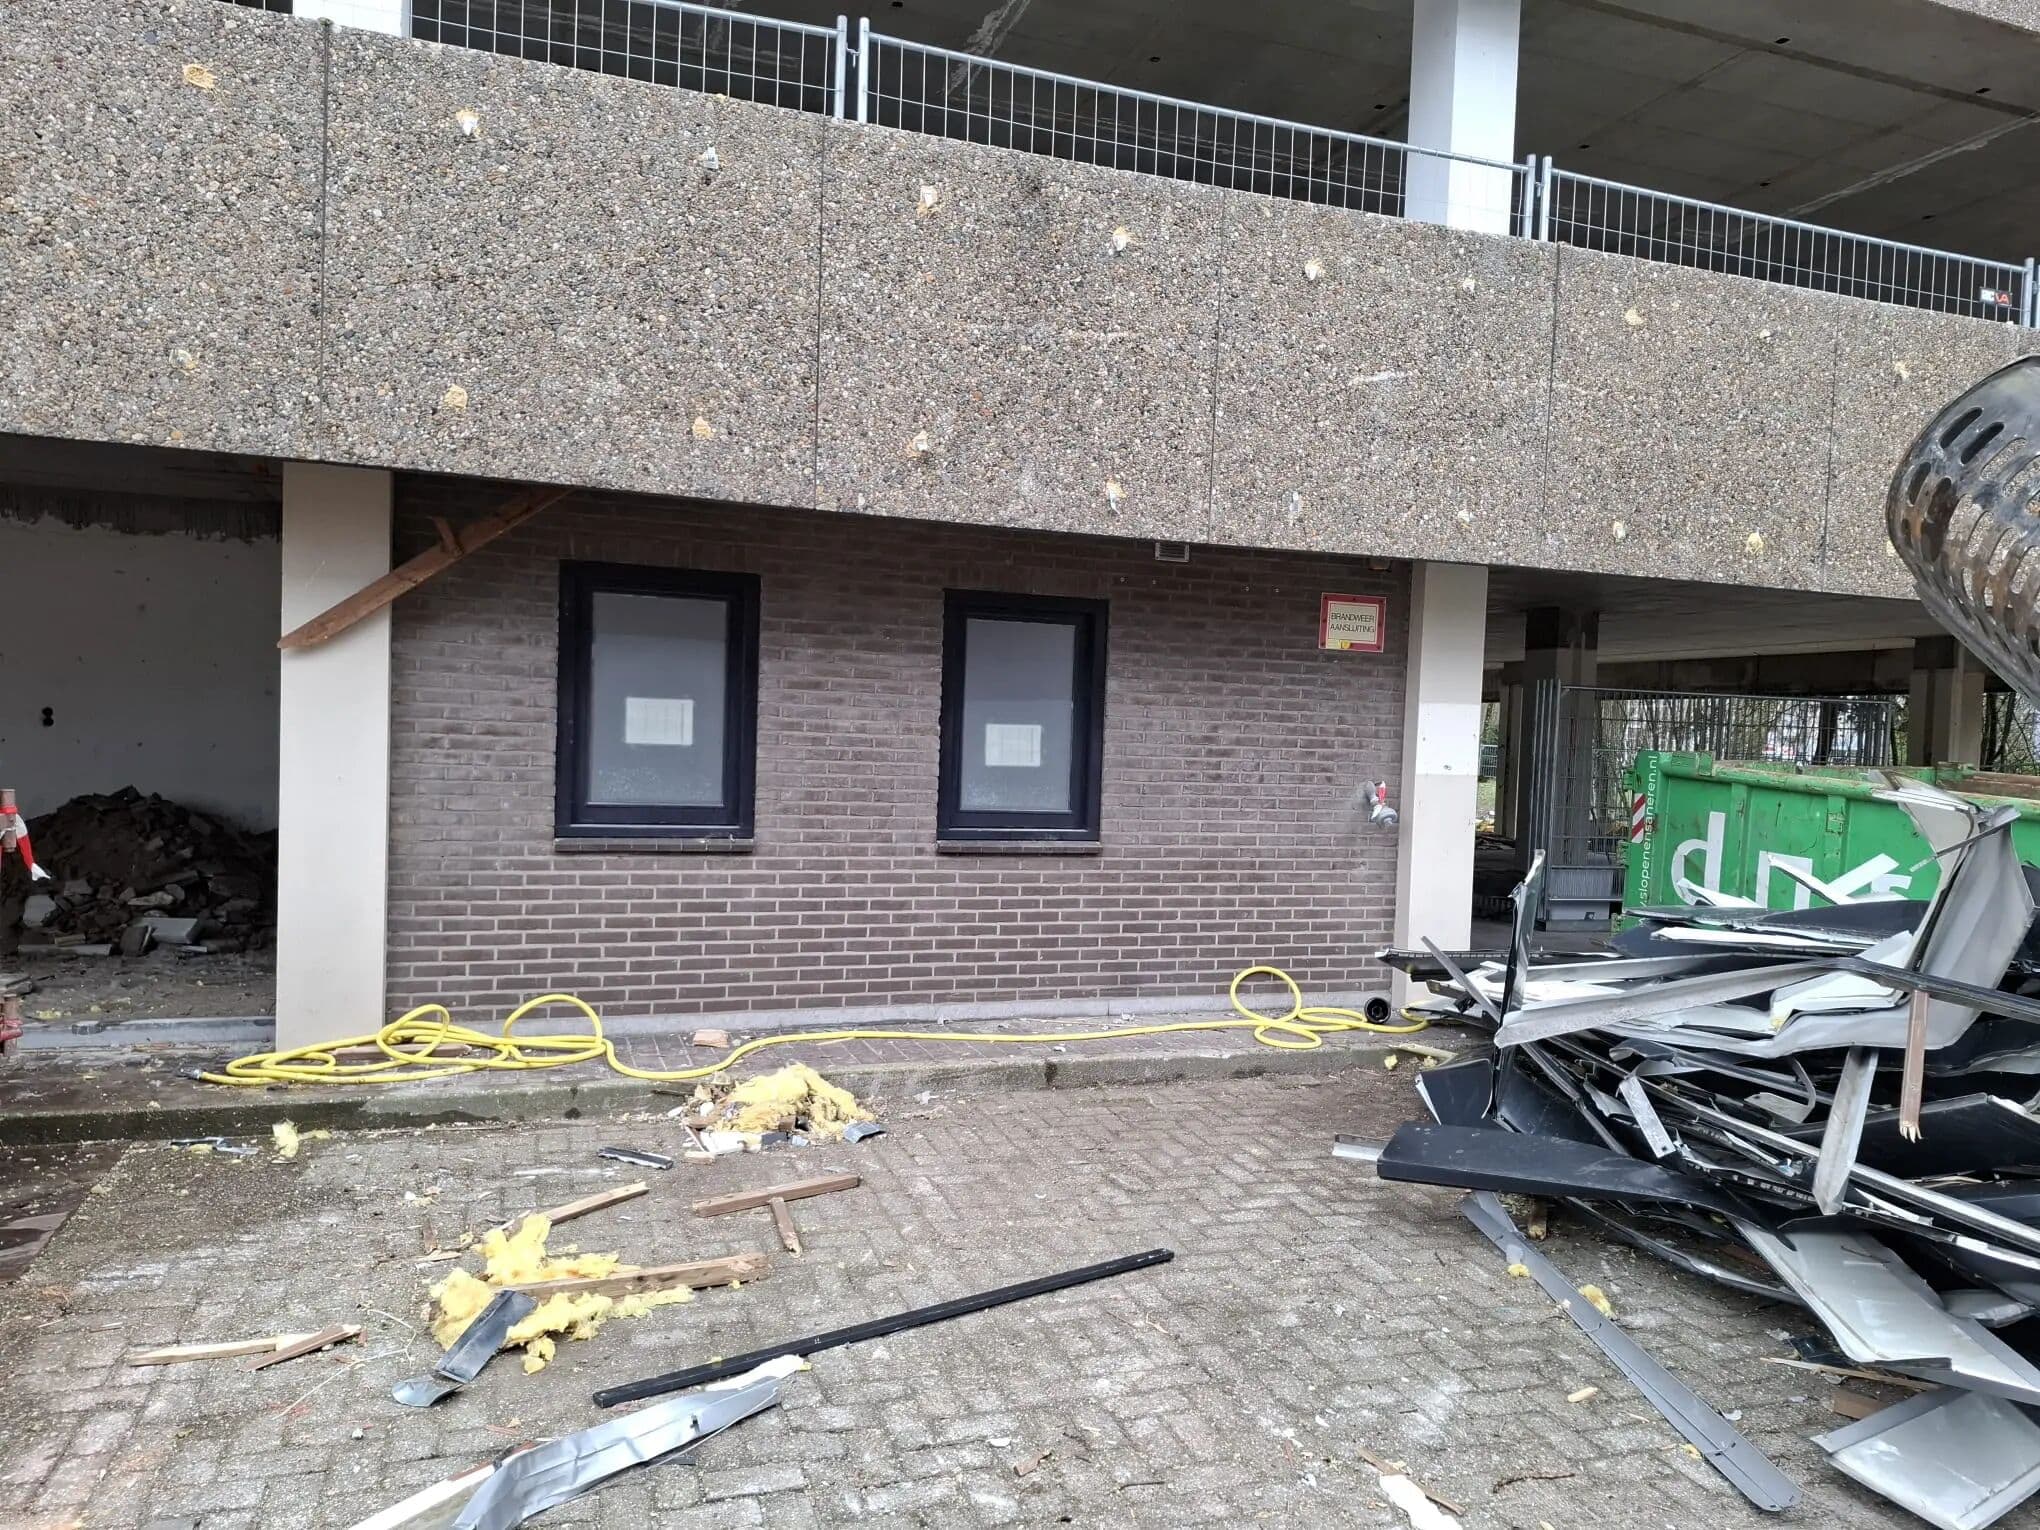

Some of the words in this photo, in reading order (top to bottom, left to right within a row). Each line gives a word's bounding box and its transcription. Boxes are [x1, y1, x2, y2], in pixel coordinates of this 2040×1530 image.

[1331, 612, 1374, 622] BRANDWEER
[1330, 623, 1374, 632] AANSLUITING
[1638, 755, 1658, 927] .slopenensaneren.nl
